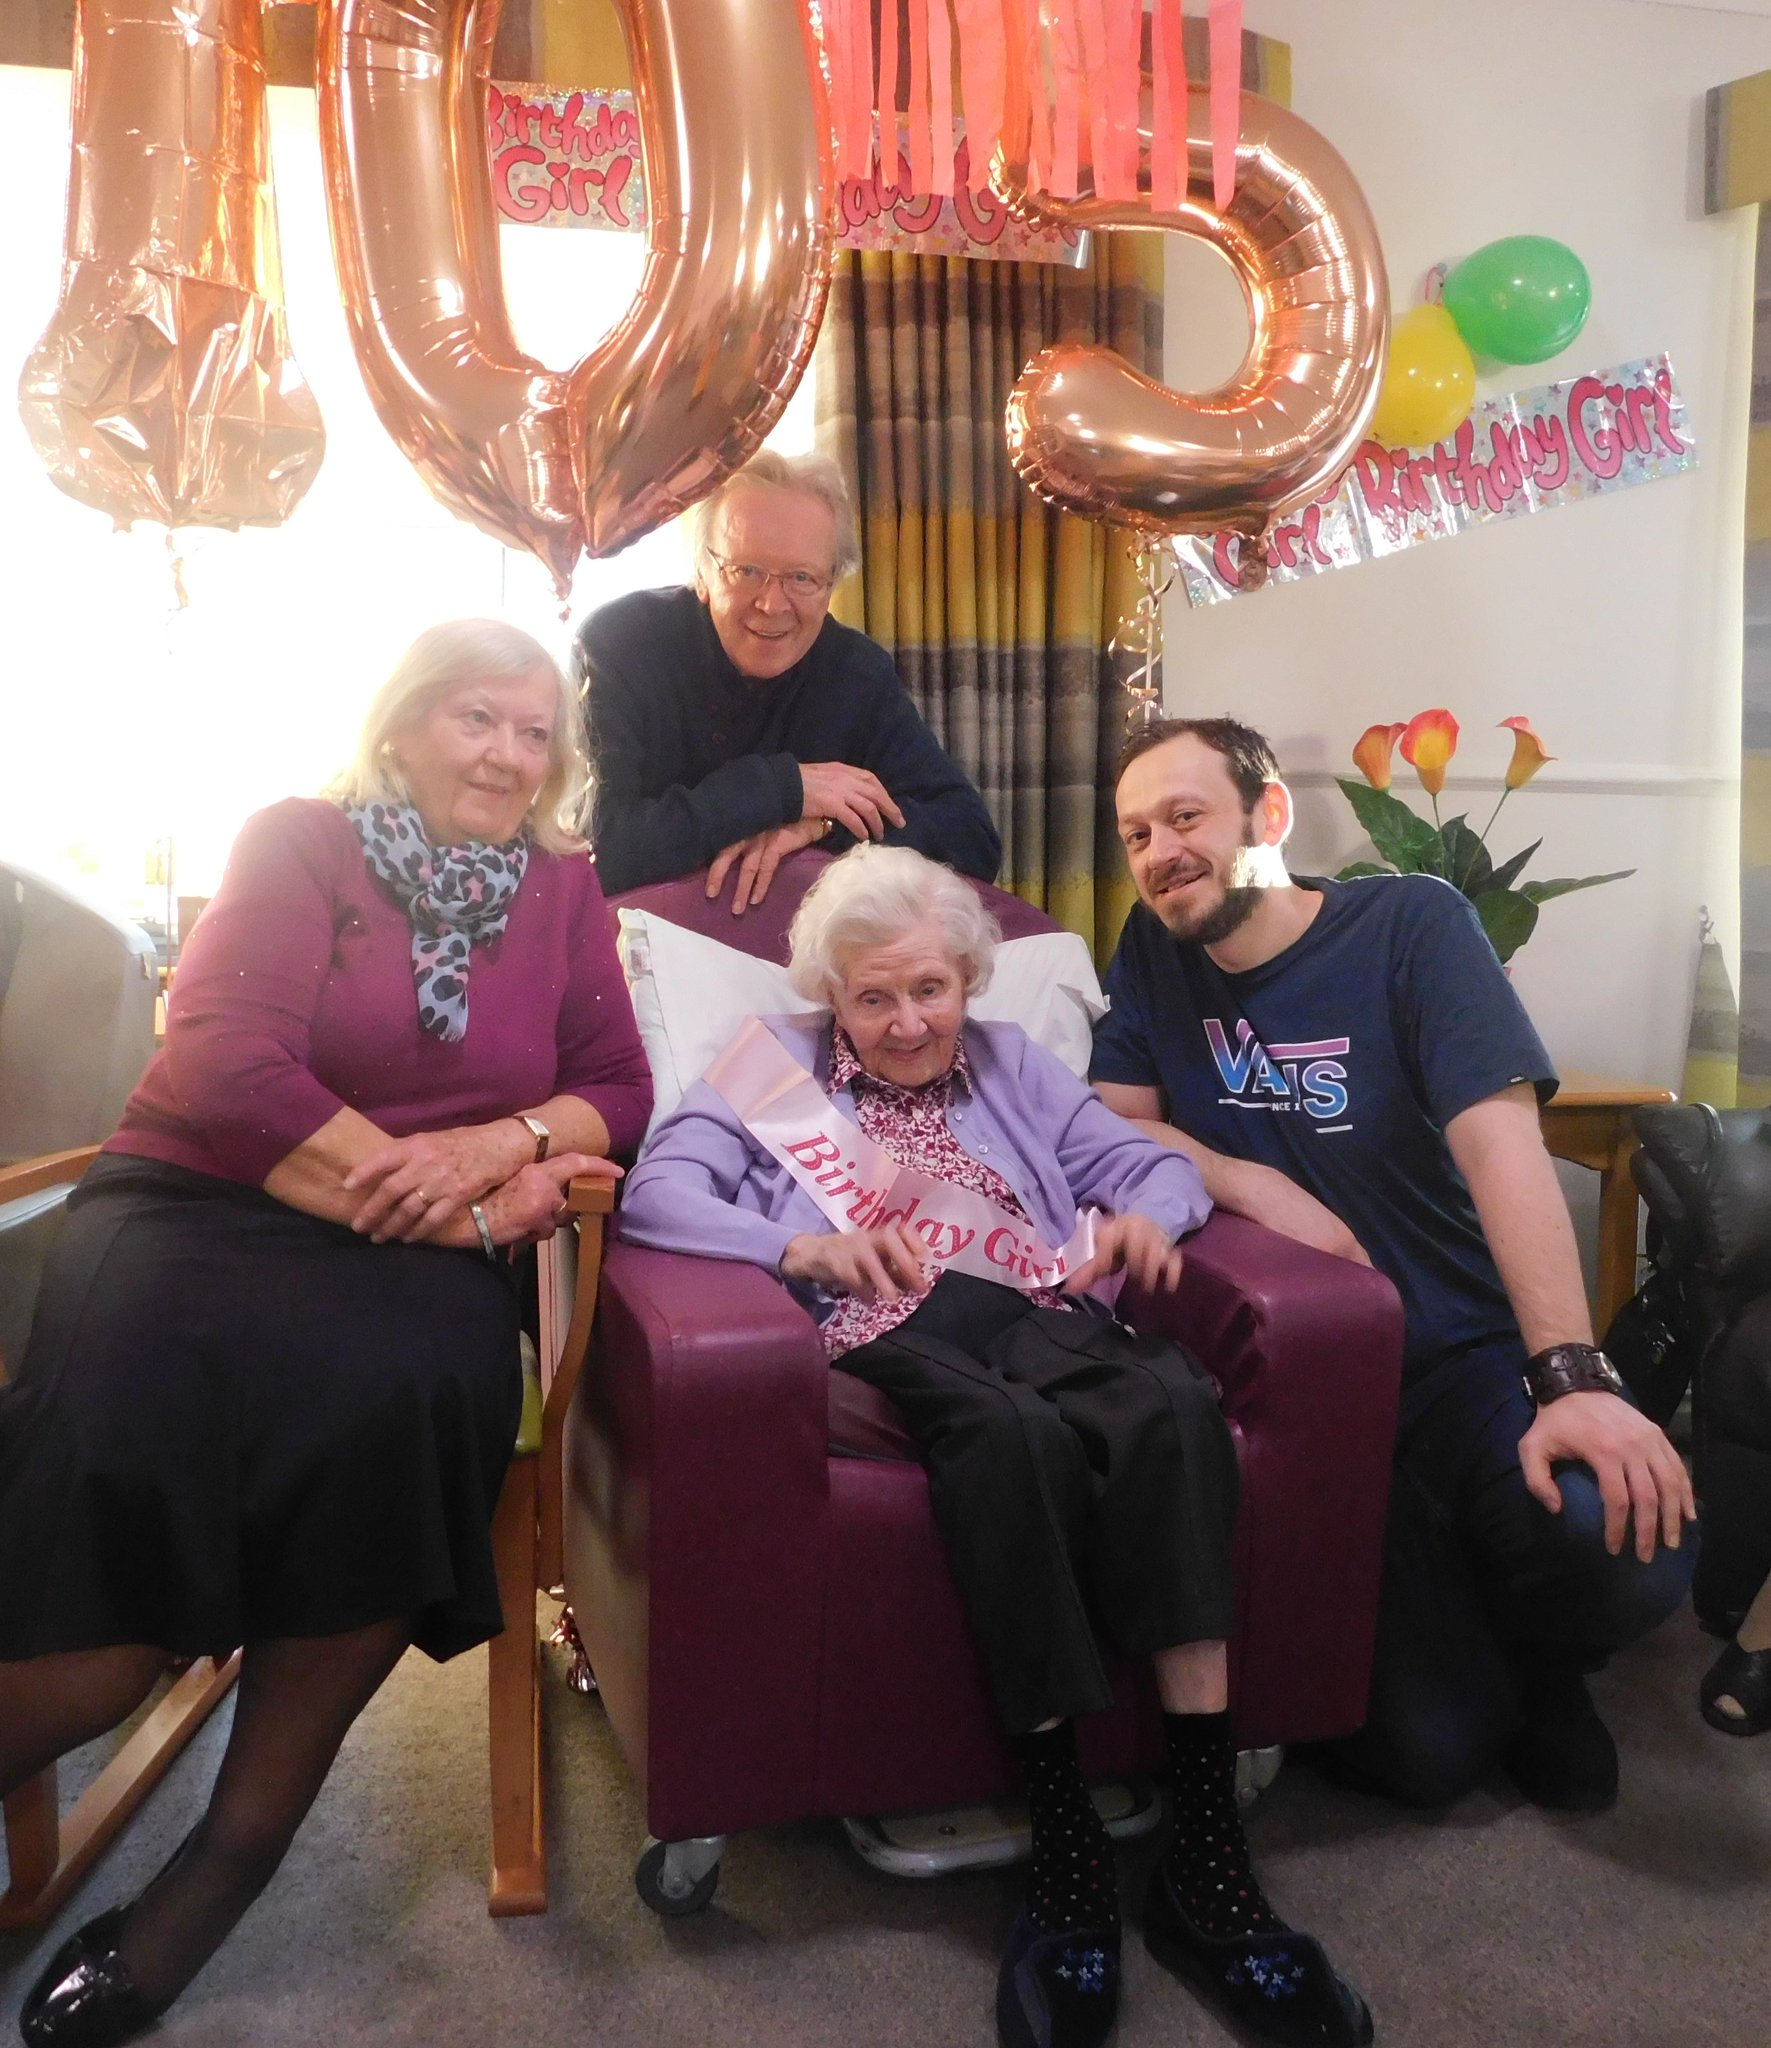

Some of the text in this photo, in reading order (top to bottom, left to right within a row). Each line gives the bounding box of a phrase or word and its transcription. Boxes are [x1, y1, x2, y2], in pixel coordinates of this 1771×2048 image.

[493, 145, 633, 228] Girl
[1353, 368, 1685, 542] Birthday Girl
[780, 1130, 1070, 1280] Birthday Girl
